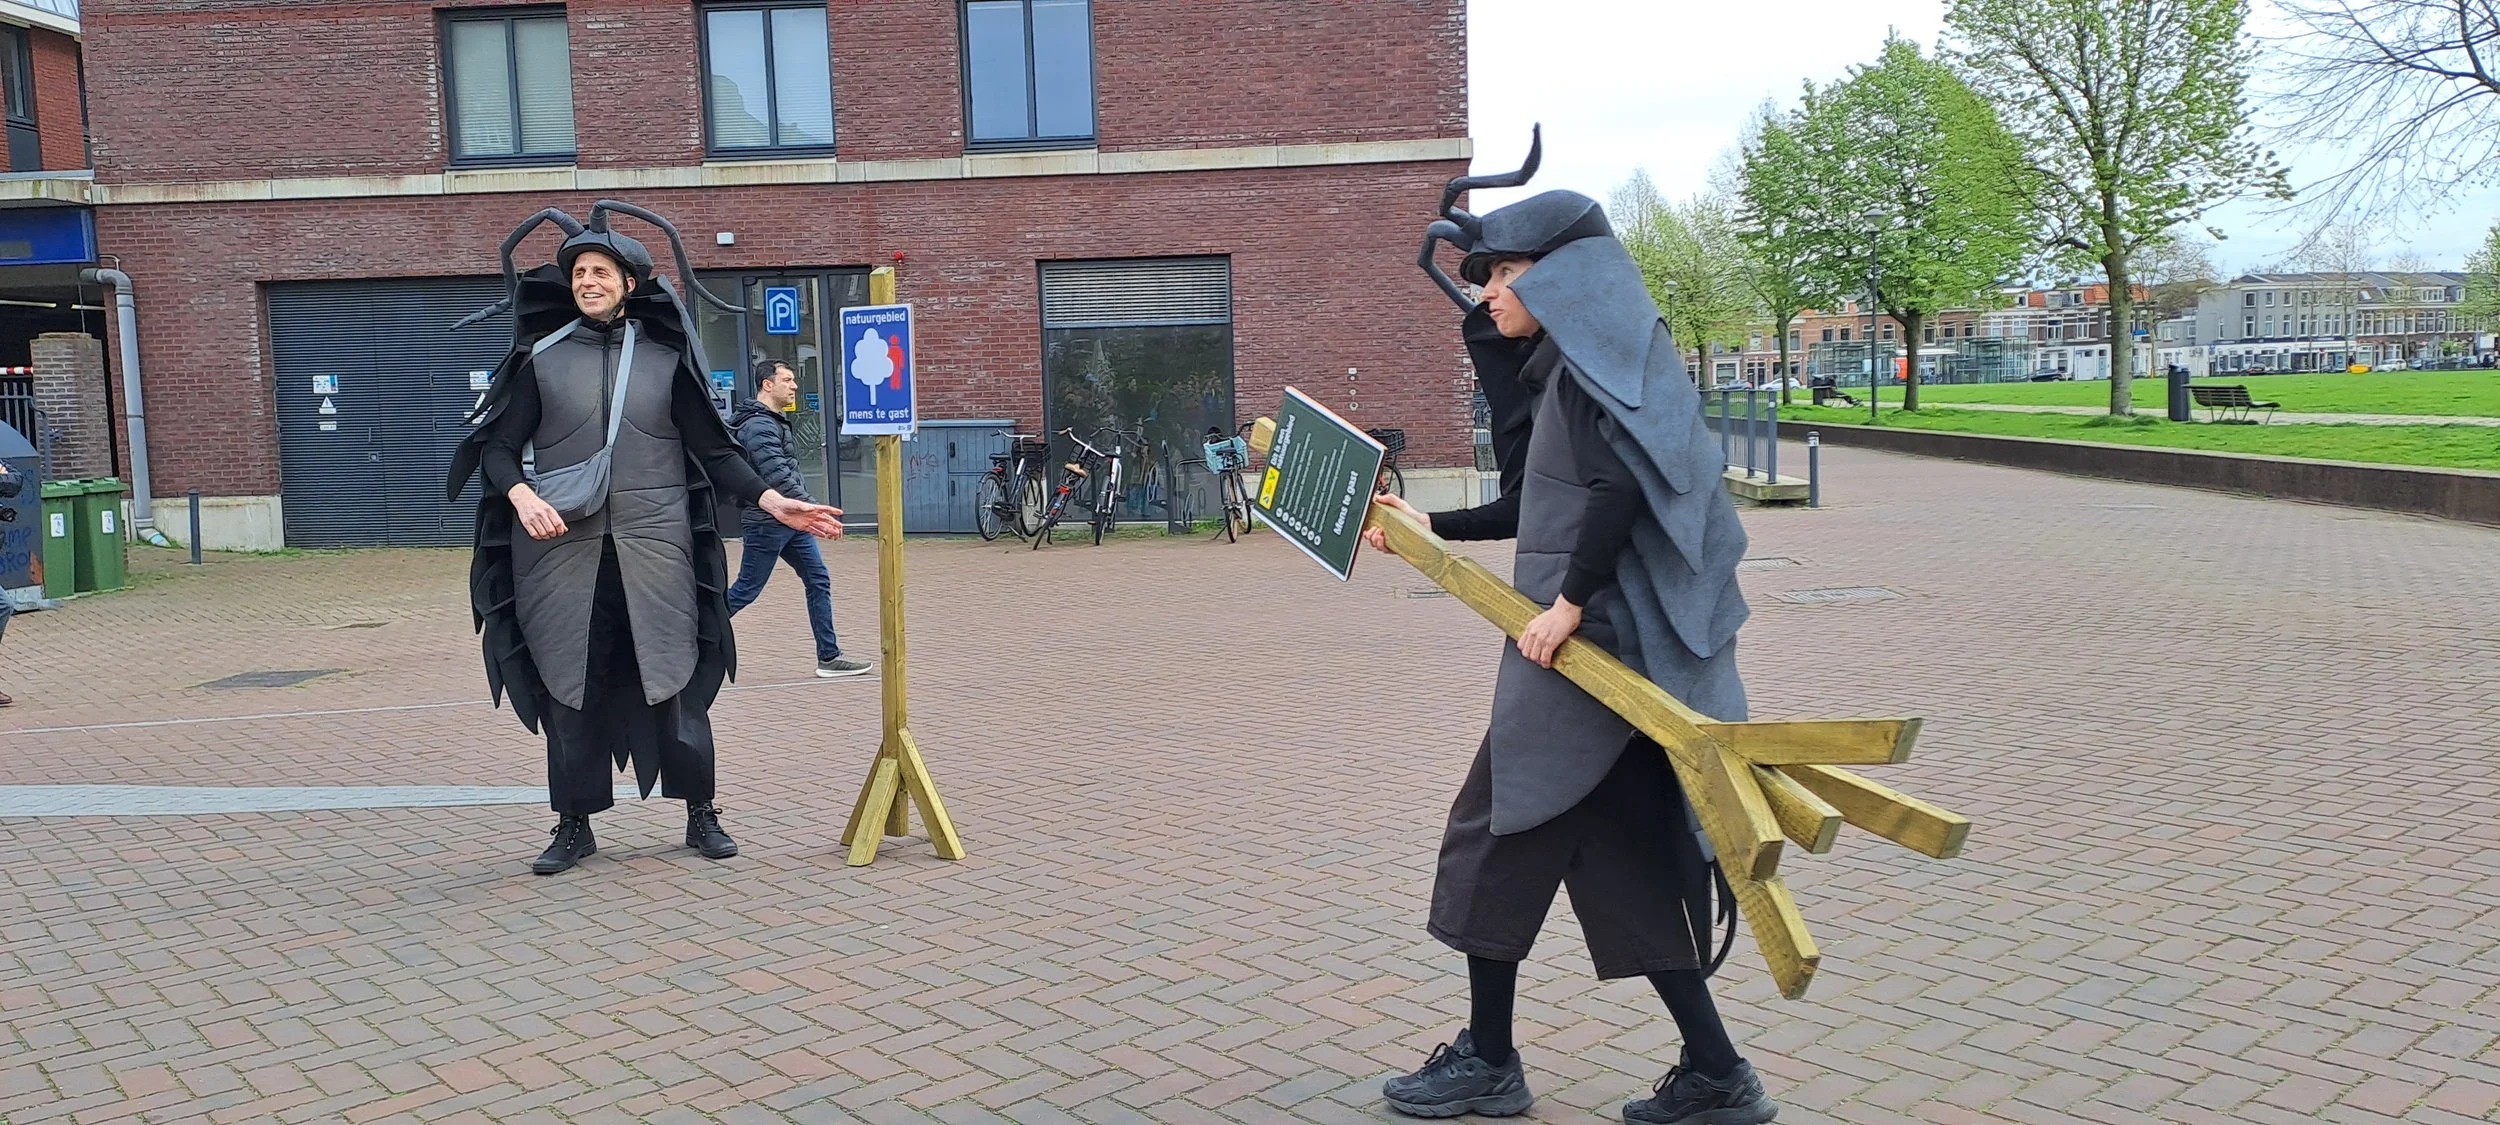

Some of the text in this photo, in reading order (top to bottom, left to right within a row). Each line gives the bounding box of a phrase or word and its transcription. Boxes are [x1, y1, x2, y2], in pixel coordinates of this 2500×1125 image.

[777, 303, 790, 327] P
[846, 311, 905, 325] natuurgebied
[849, 408, 909, 421] mens te gast
[1333, 470, 1358, 536] Mens te gast
